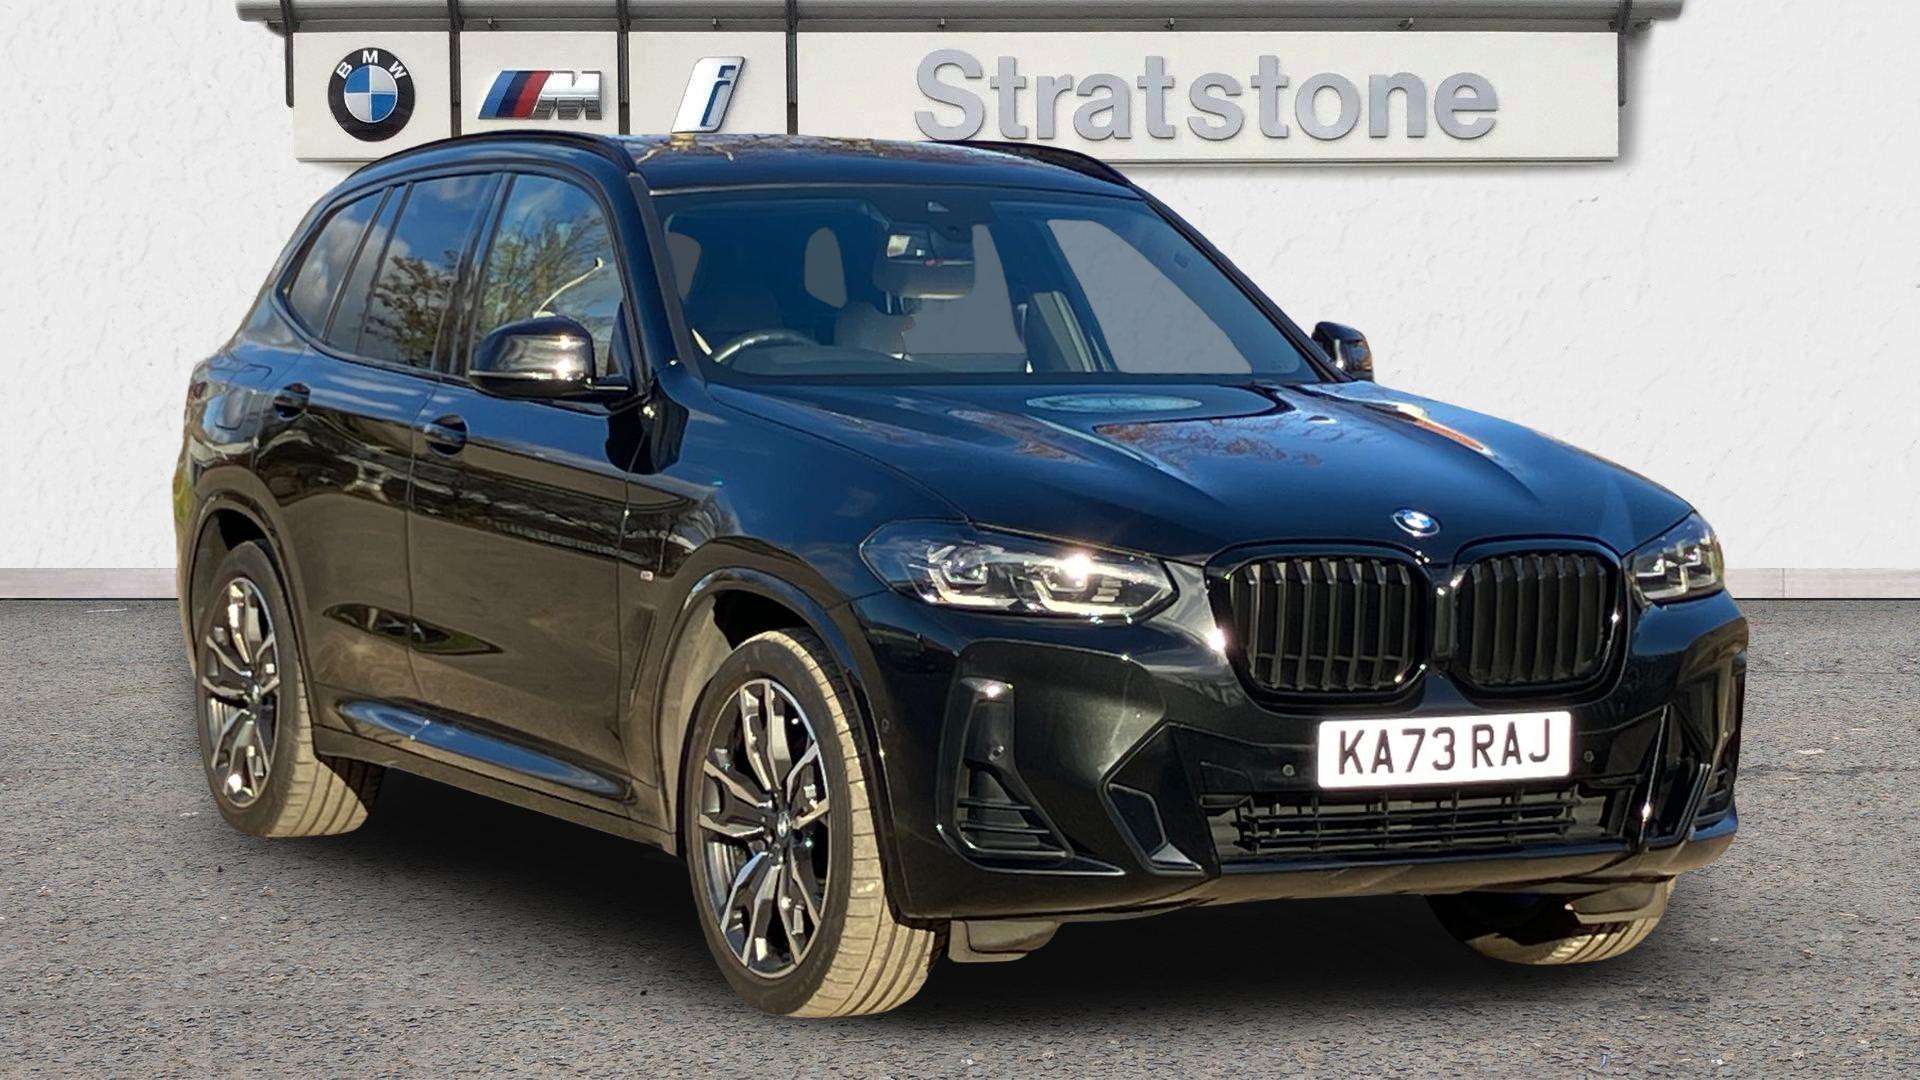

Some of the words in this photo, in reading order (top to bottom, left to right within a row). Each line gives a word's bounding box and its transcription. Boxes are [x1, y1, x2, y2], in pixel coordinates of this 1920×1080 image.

[335, 49, 407, 79] BMW
[914, 48, 1499, 141] Stratstone
[1337, 727, 1456, 775] KA73
[1471, 718, 1550, 768] RAJ
